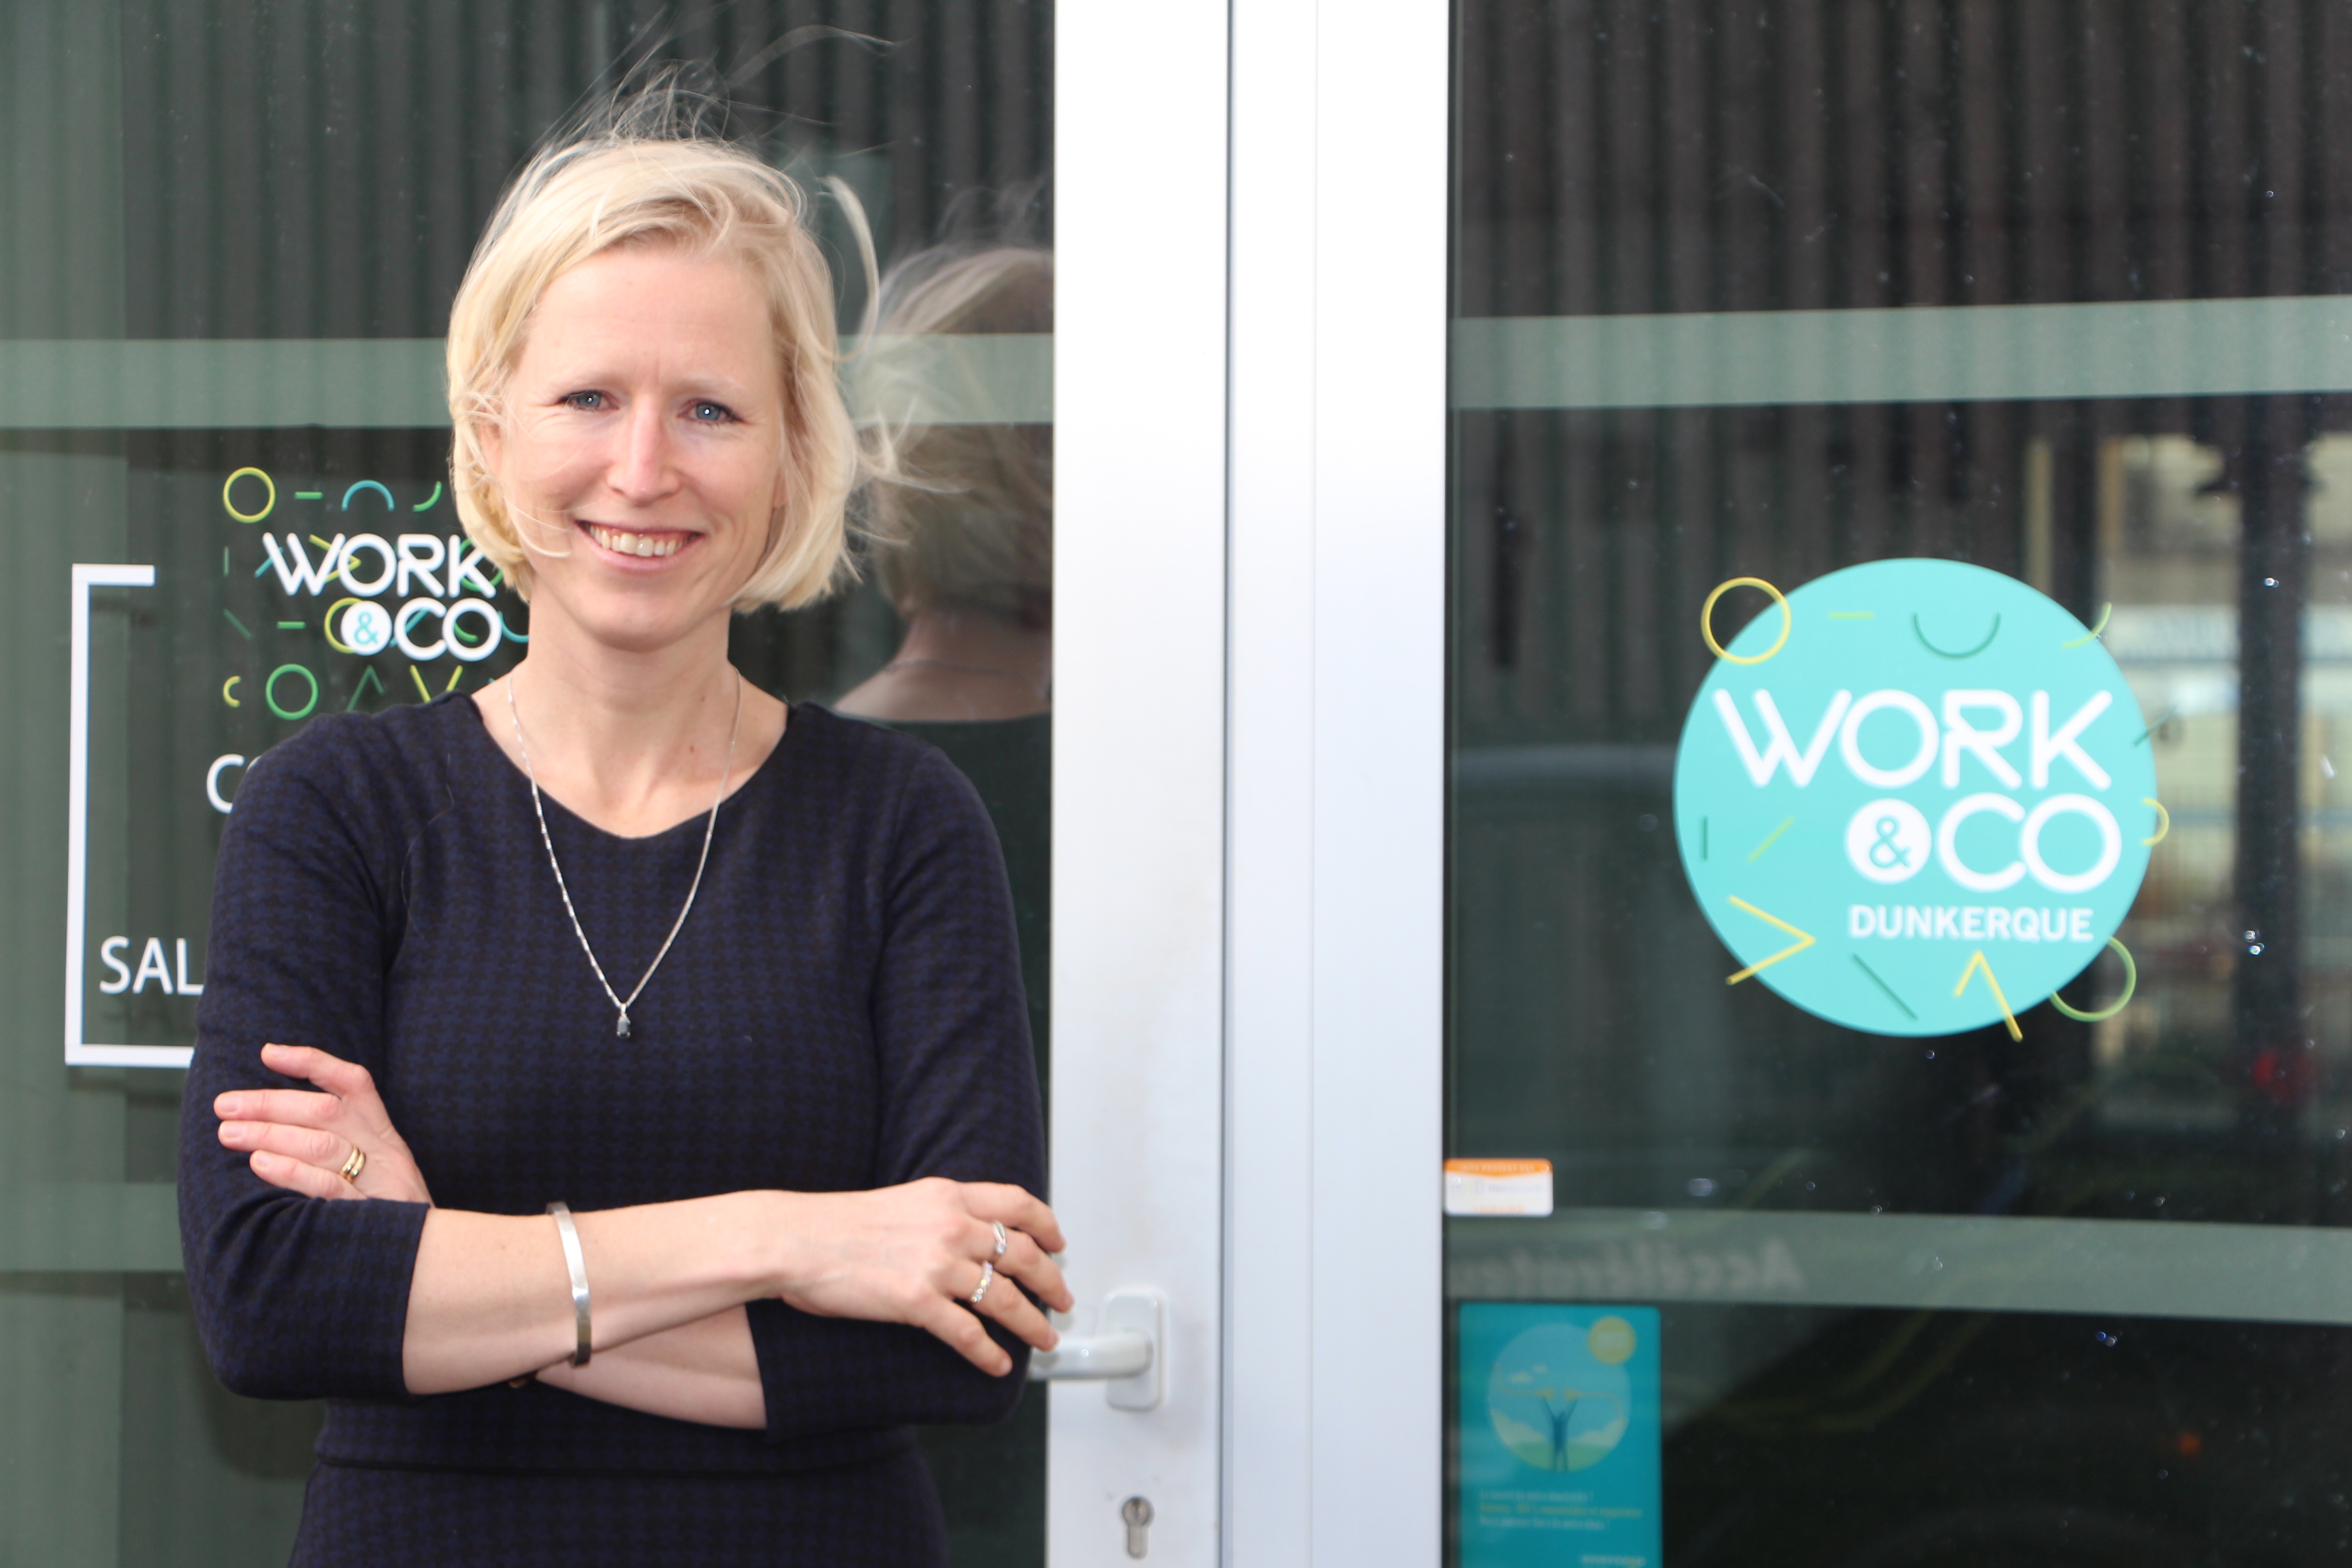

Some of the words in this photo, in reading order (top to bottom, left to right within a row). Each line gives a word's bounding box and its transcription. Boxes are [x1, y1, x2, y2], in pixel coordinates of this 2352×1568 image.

[262, 532, 497, 599] WORK
[1712, 688, 2114, 790] WORK
[206, 753, 262, 814] C
[1848, 904, 2095, 944] DUNKERQUE
